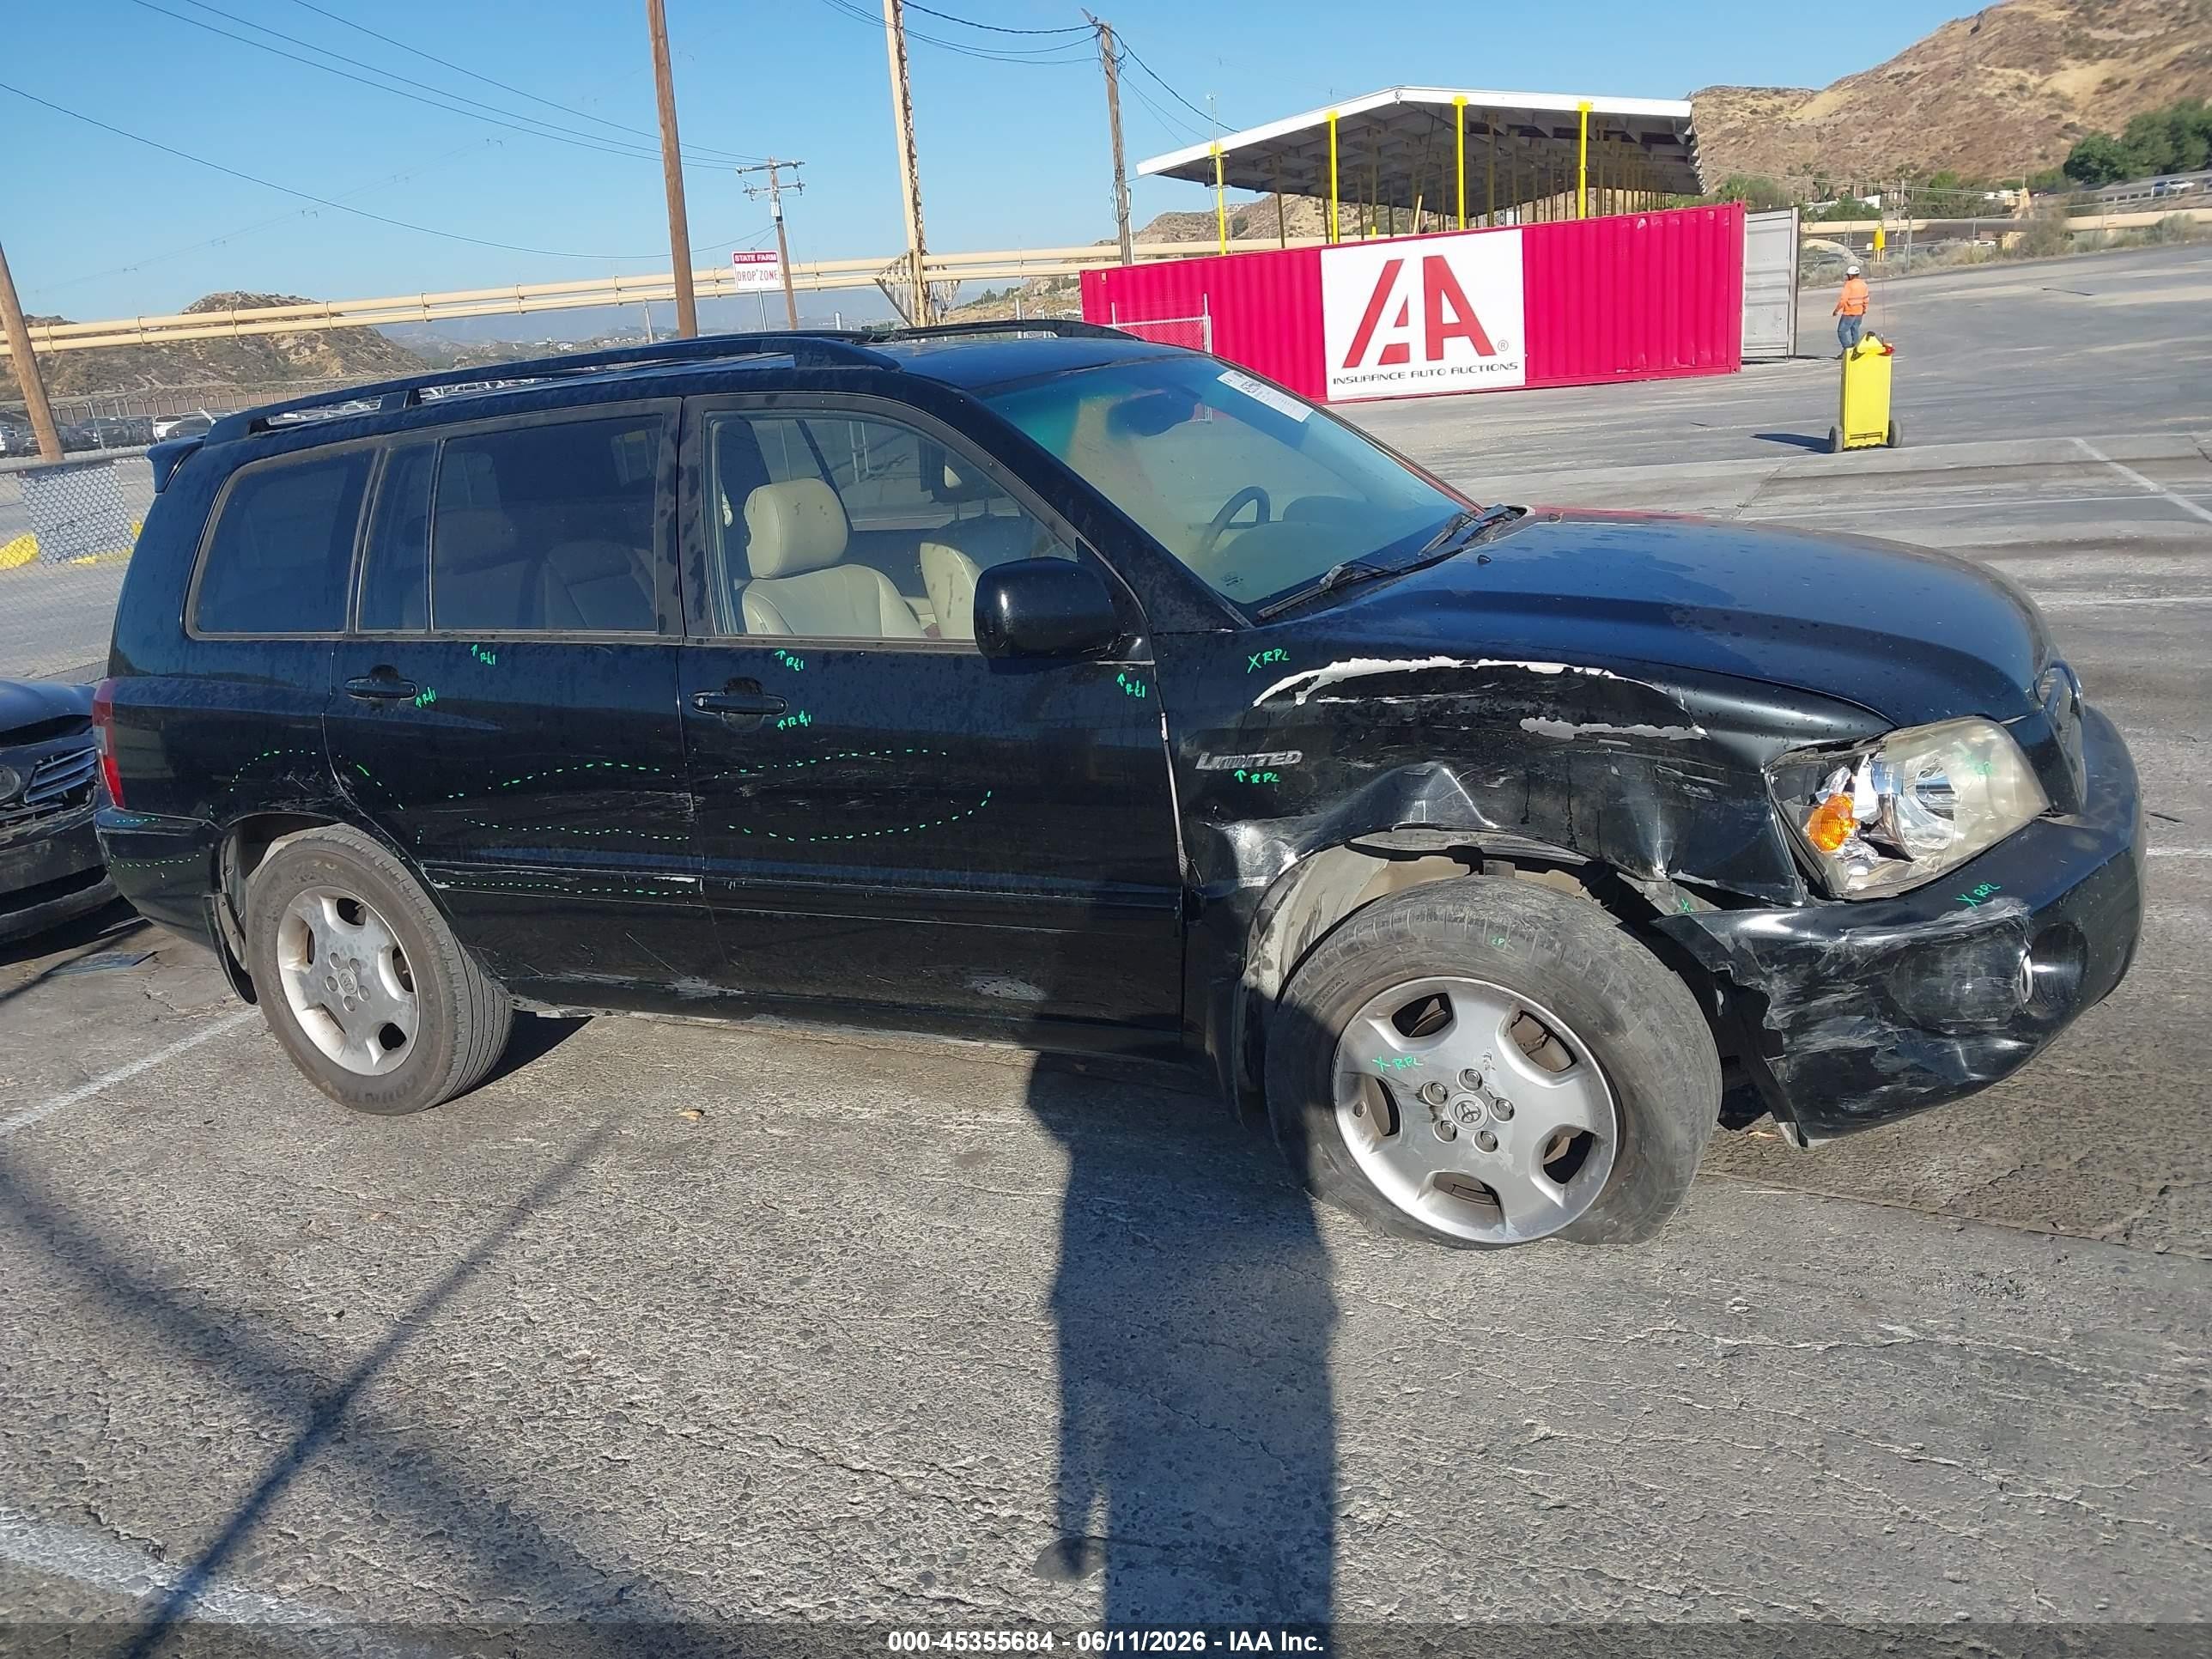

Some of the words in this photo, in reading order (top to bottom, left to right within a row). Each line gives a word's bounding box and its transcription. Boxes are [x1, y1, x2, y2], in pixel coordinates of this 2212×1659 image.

[737, 270, 757, 282] DROP
[759, 270, 778, 281] ZONE
[1332, 371, 1407, 385] INSURANCE
[1411, 368, 1447, 379] AUTO
[1451, 362, 1519, 375] AUCTIONS
[1194, 750, 1304, 770] LIMITED
